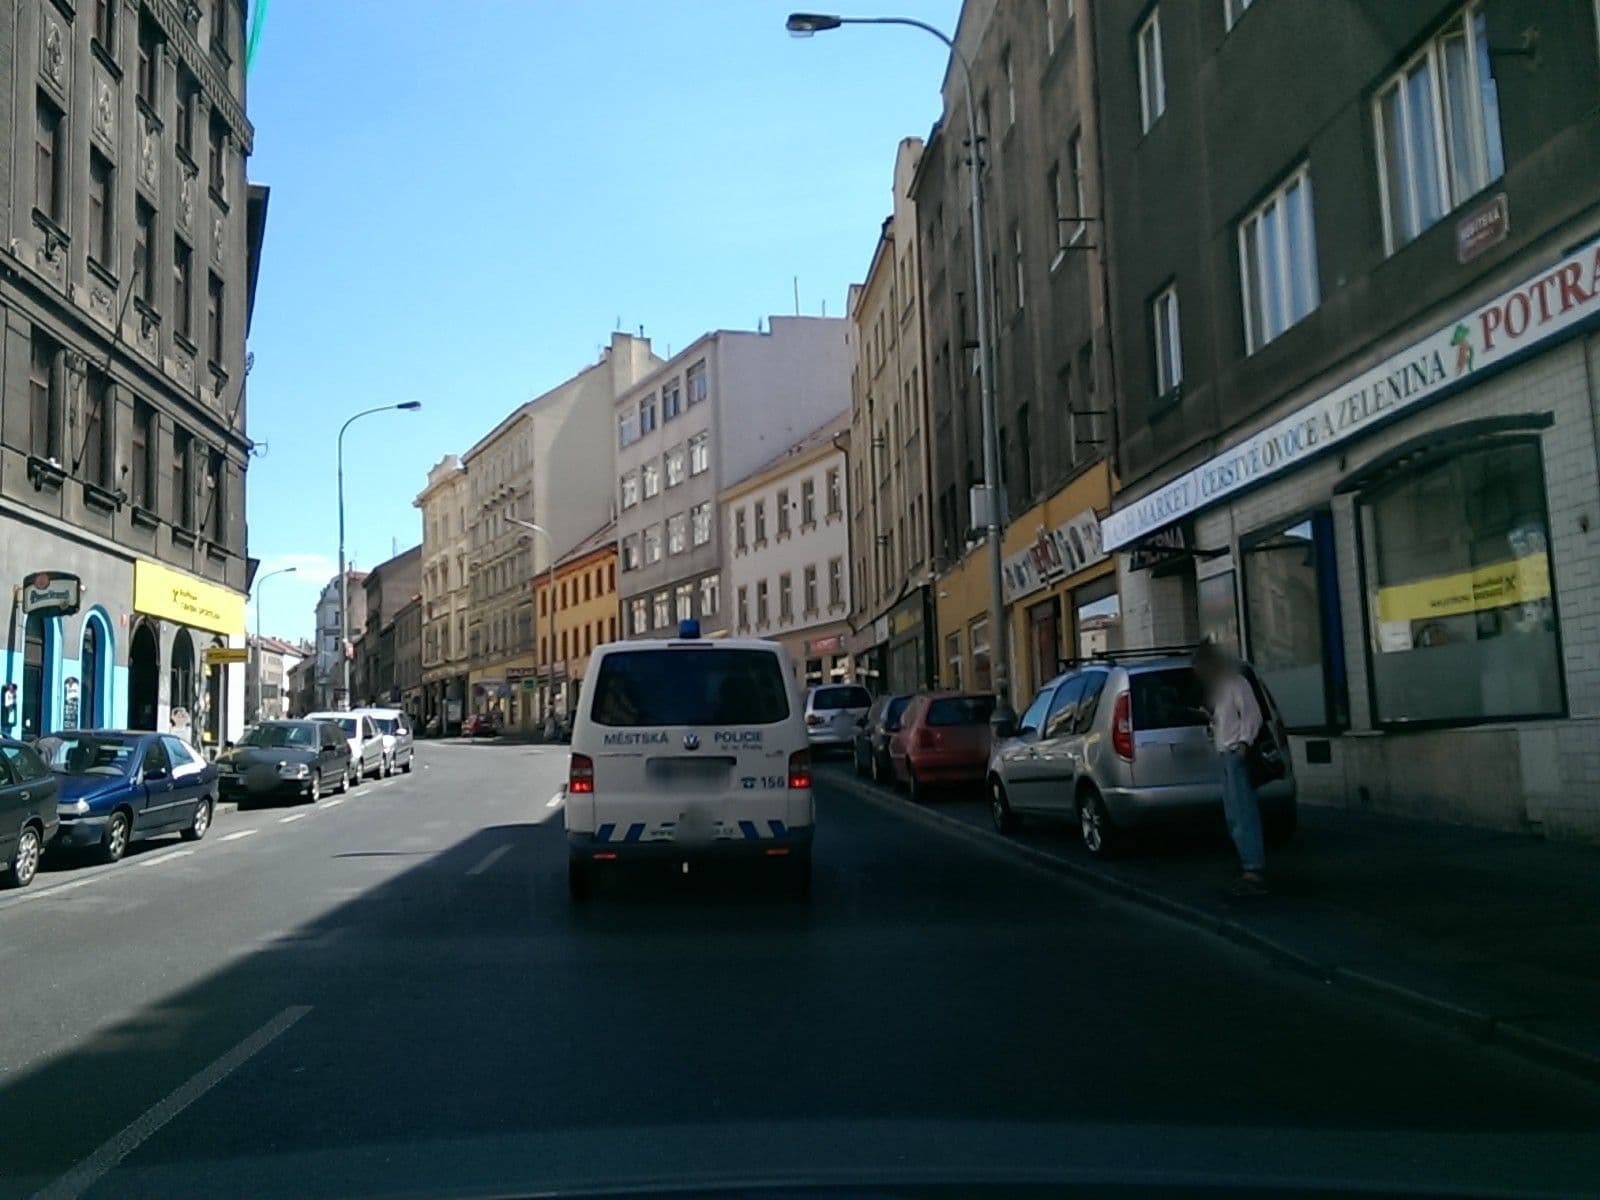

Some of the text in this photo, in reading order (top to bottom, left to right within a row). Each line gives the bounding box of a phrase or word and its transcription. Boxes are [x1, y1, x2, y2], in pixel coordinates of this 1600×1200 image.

[1138, 482, 1189, 525] MARKET
[1201, 440, 1260, 497] ČERSTVÉ
[1262, 416, 1319, 468] OVOCE
[1338, 350, 1447, 430] ZELENINA
[604, 731, 763, 745] MĚSTSKÁ POLICIE
